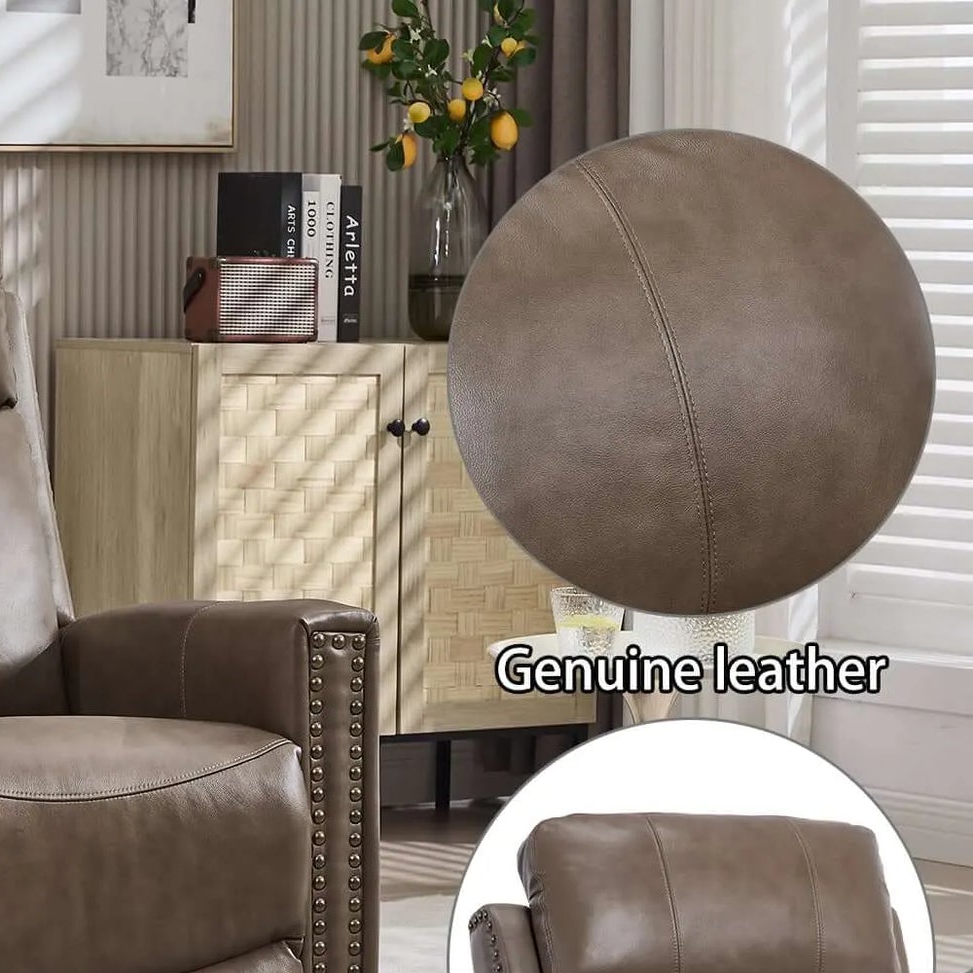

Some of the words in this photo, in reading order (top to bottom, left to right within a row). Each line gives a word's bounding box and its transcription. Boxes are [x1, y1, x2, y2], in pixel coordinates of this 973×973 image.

[287, 204, 296, 234] ARTS
[307, 200, 317, 238] 1000
[325, 201, 336, 279] CLOTHING
[343, 215, 360, 297] Arletta
